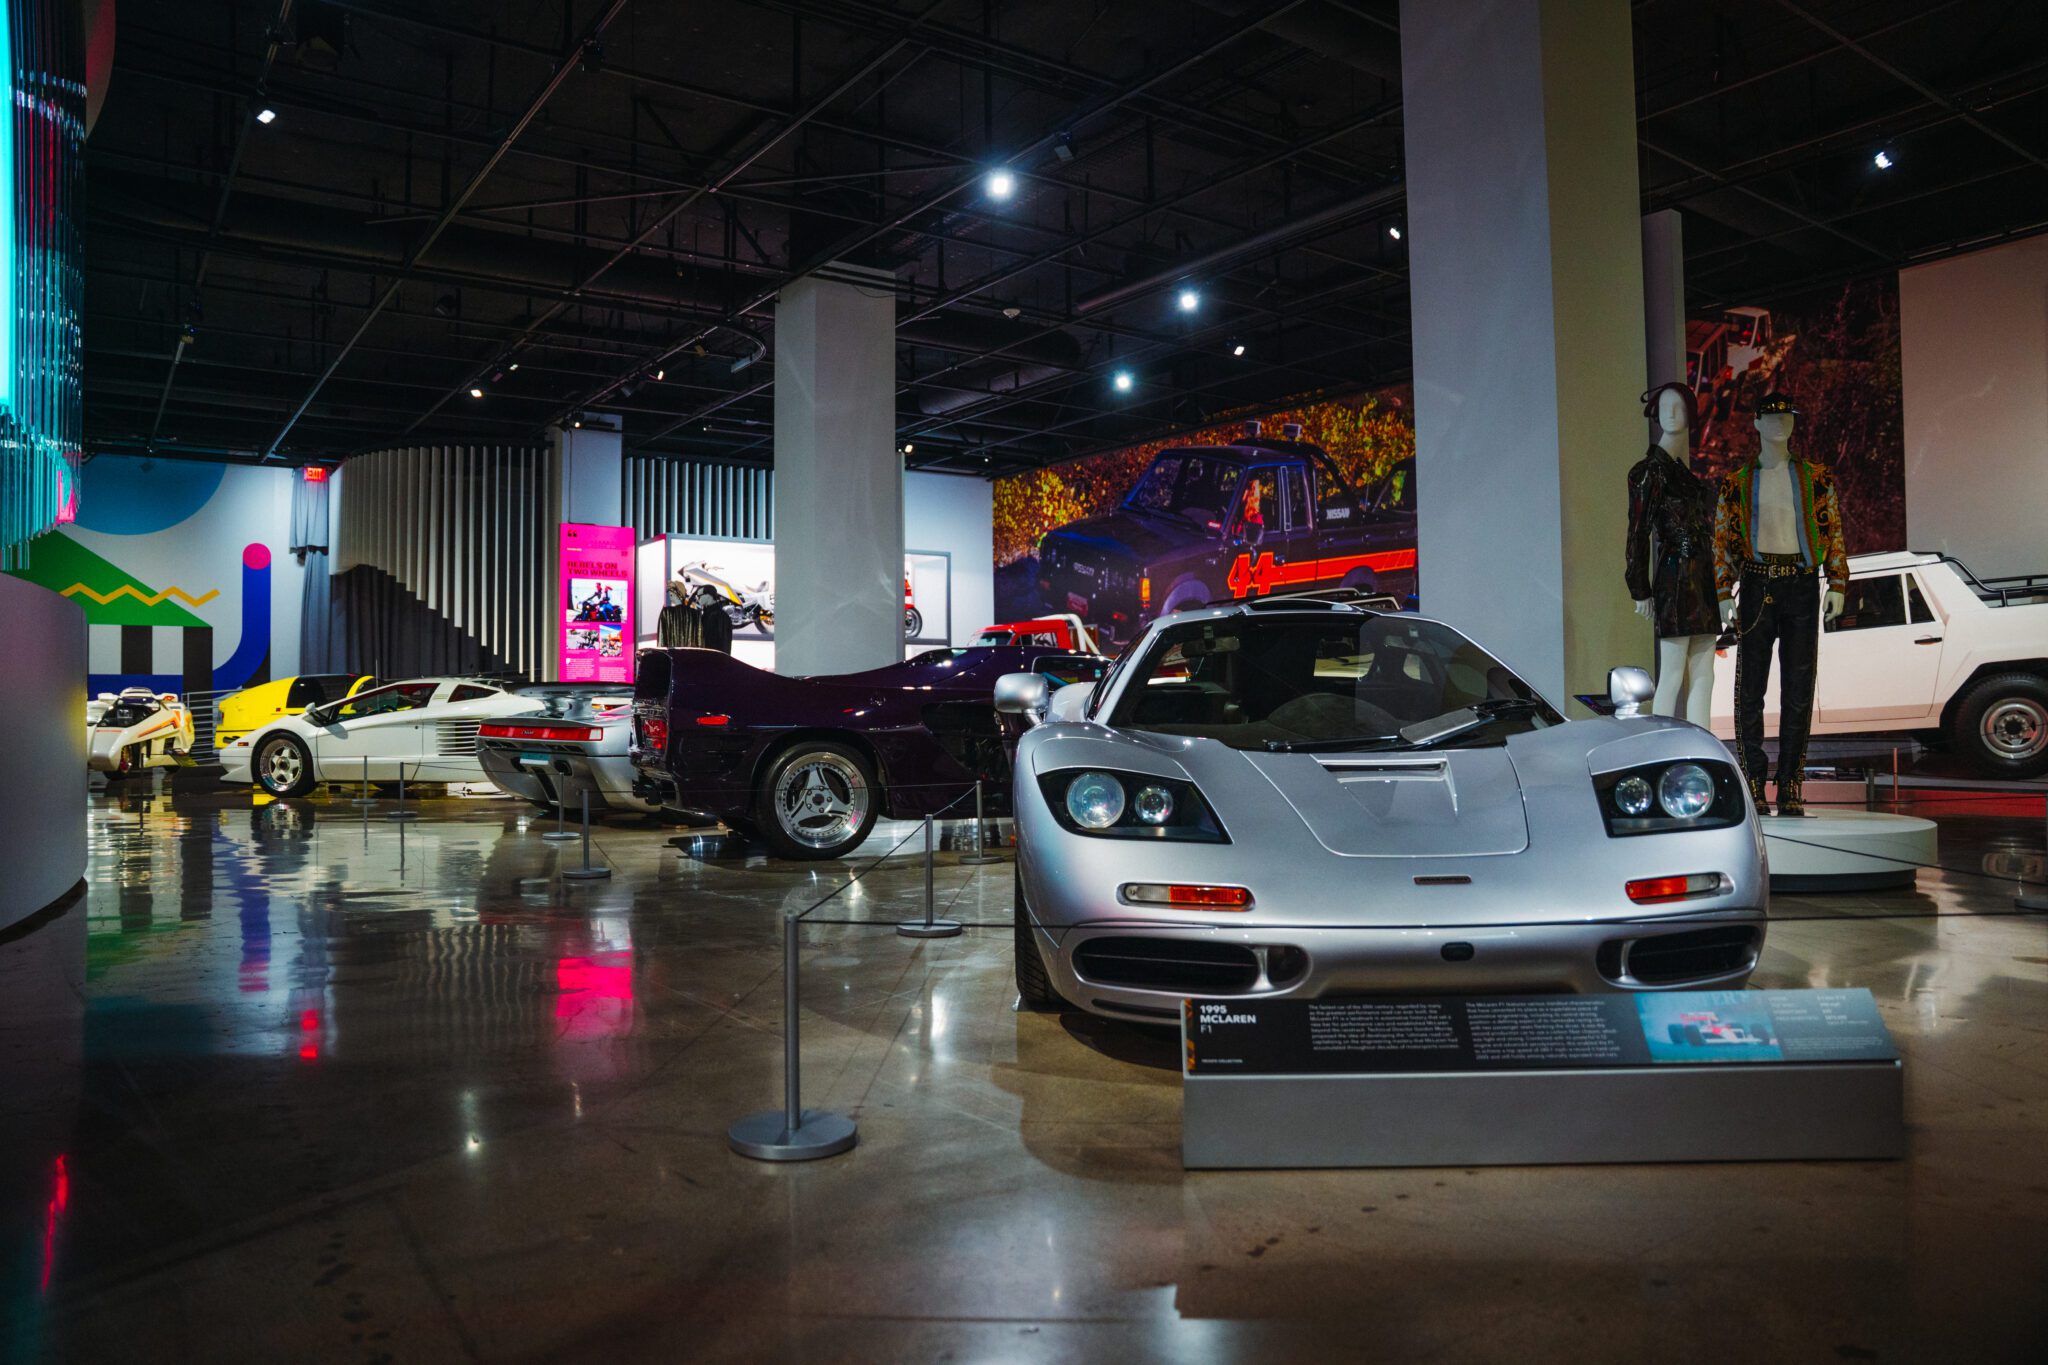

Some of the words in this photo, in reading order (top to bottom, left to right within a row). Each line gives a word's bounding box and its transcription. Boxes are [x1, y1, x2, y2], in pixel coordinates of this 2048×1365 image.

[308, 468, 323, 480] EXIT
[1326, 507, 1350, 520] NISSAN
[568, 561, 603, 569] REBELS
[590, 569, 628, 577] WHEELS
[1200, 1005, 1228, 1014] 1995
[1200, 1014, 1257, 1024] MCLAREN
[1200, 1024, 1212, 1034] F1
